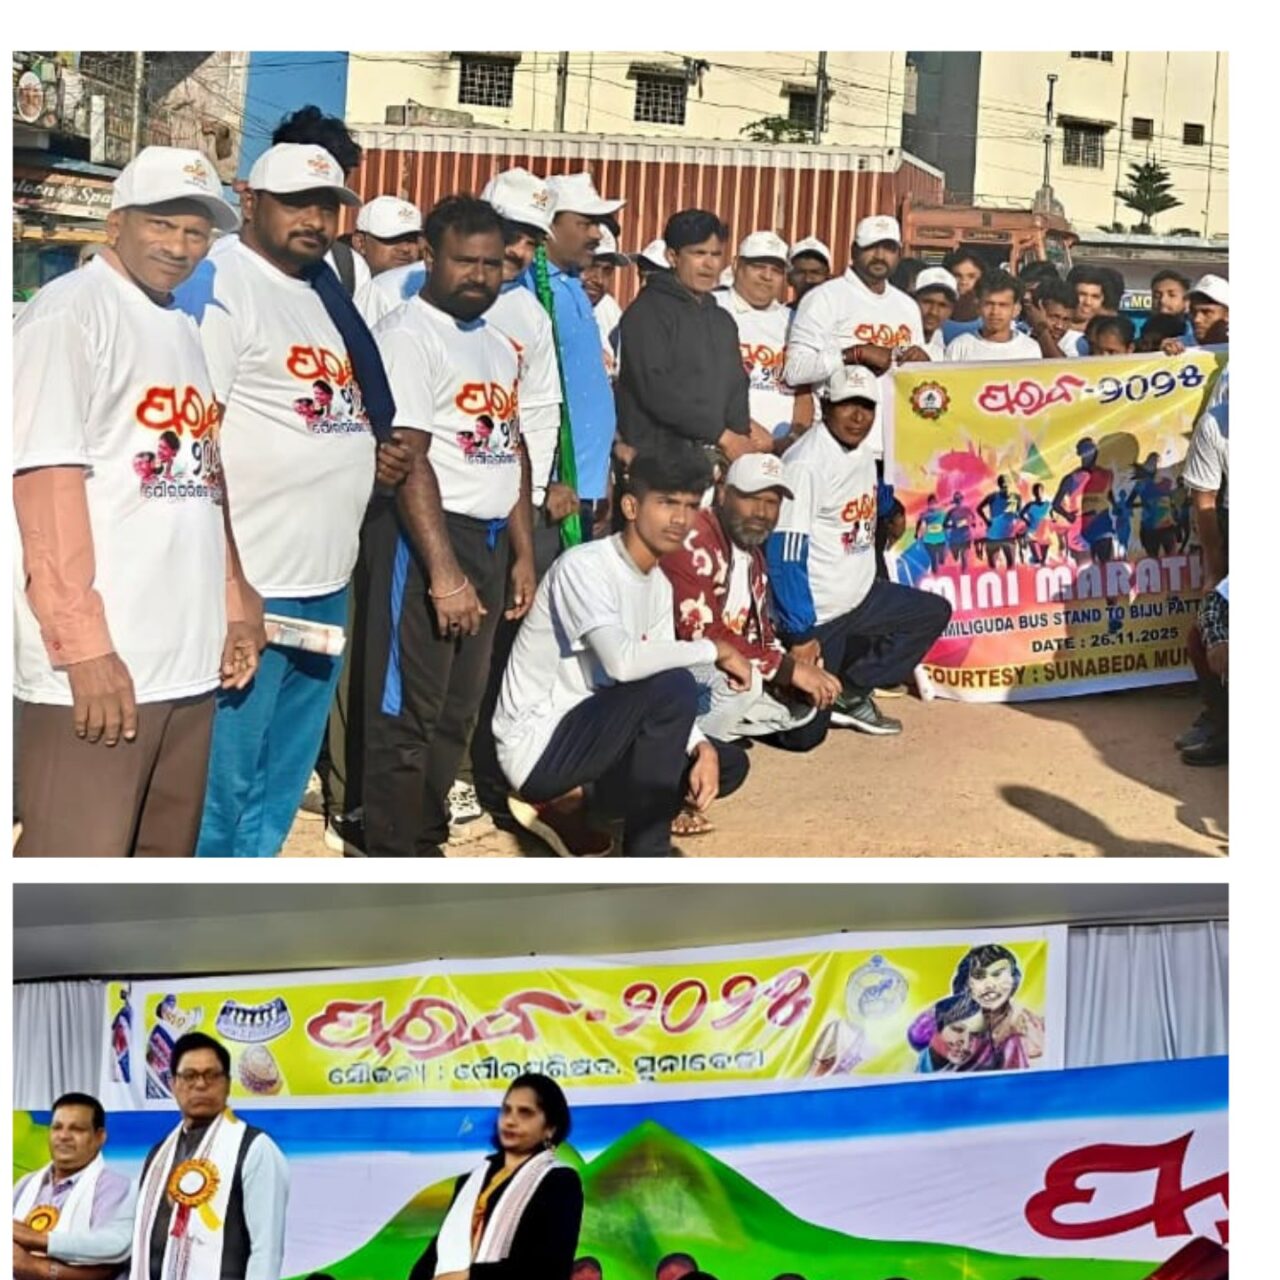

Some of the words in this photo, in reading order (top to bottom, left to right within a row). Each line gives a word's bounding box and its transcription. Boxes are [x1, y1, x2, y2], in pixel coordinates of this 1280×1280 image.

[919, 570, 1020, 612] MINI
[1019, 610, 1049, 629] BUS
[1053, 606, 1102, 626] STAND
[1107, 605, 1126, 621] TO
[1130, 601, 1163, 620] BIJU
[1031, 635, 1076, 653] DATE
[1090, 626, 1179, 649] 26.11.2025
[1044, 652, 1148, 682] SUNABEDA
